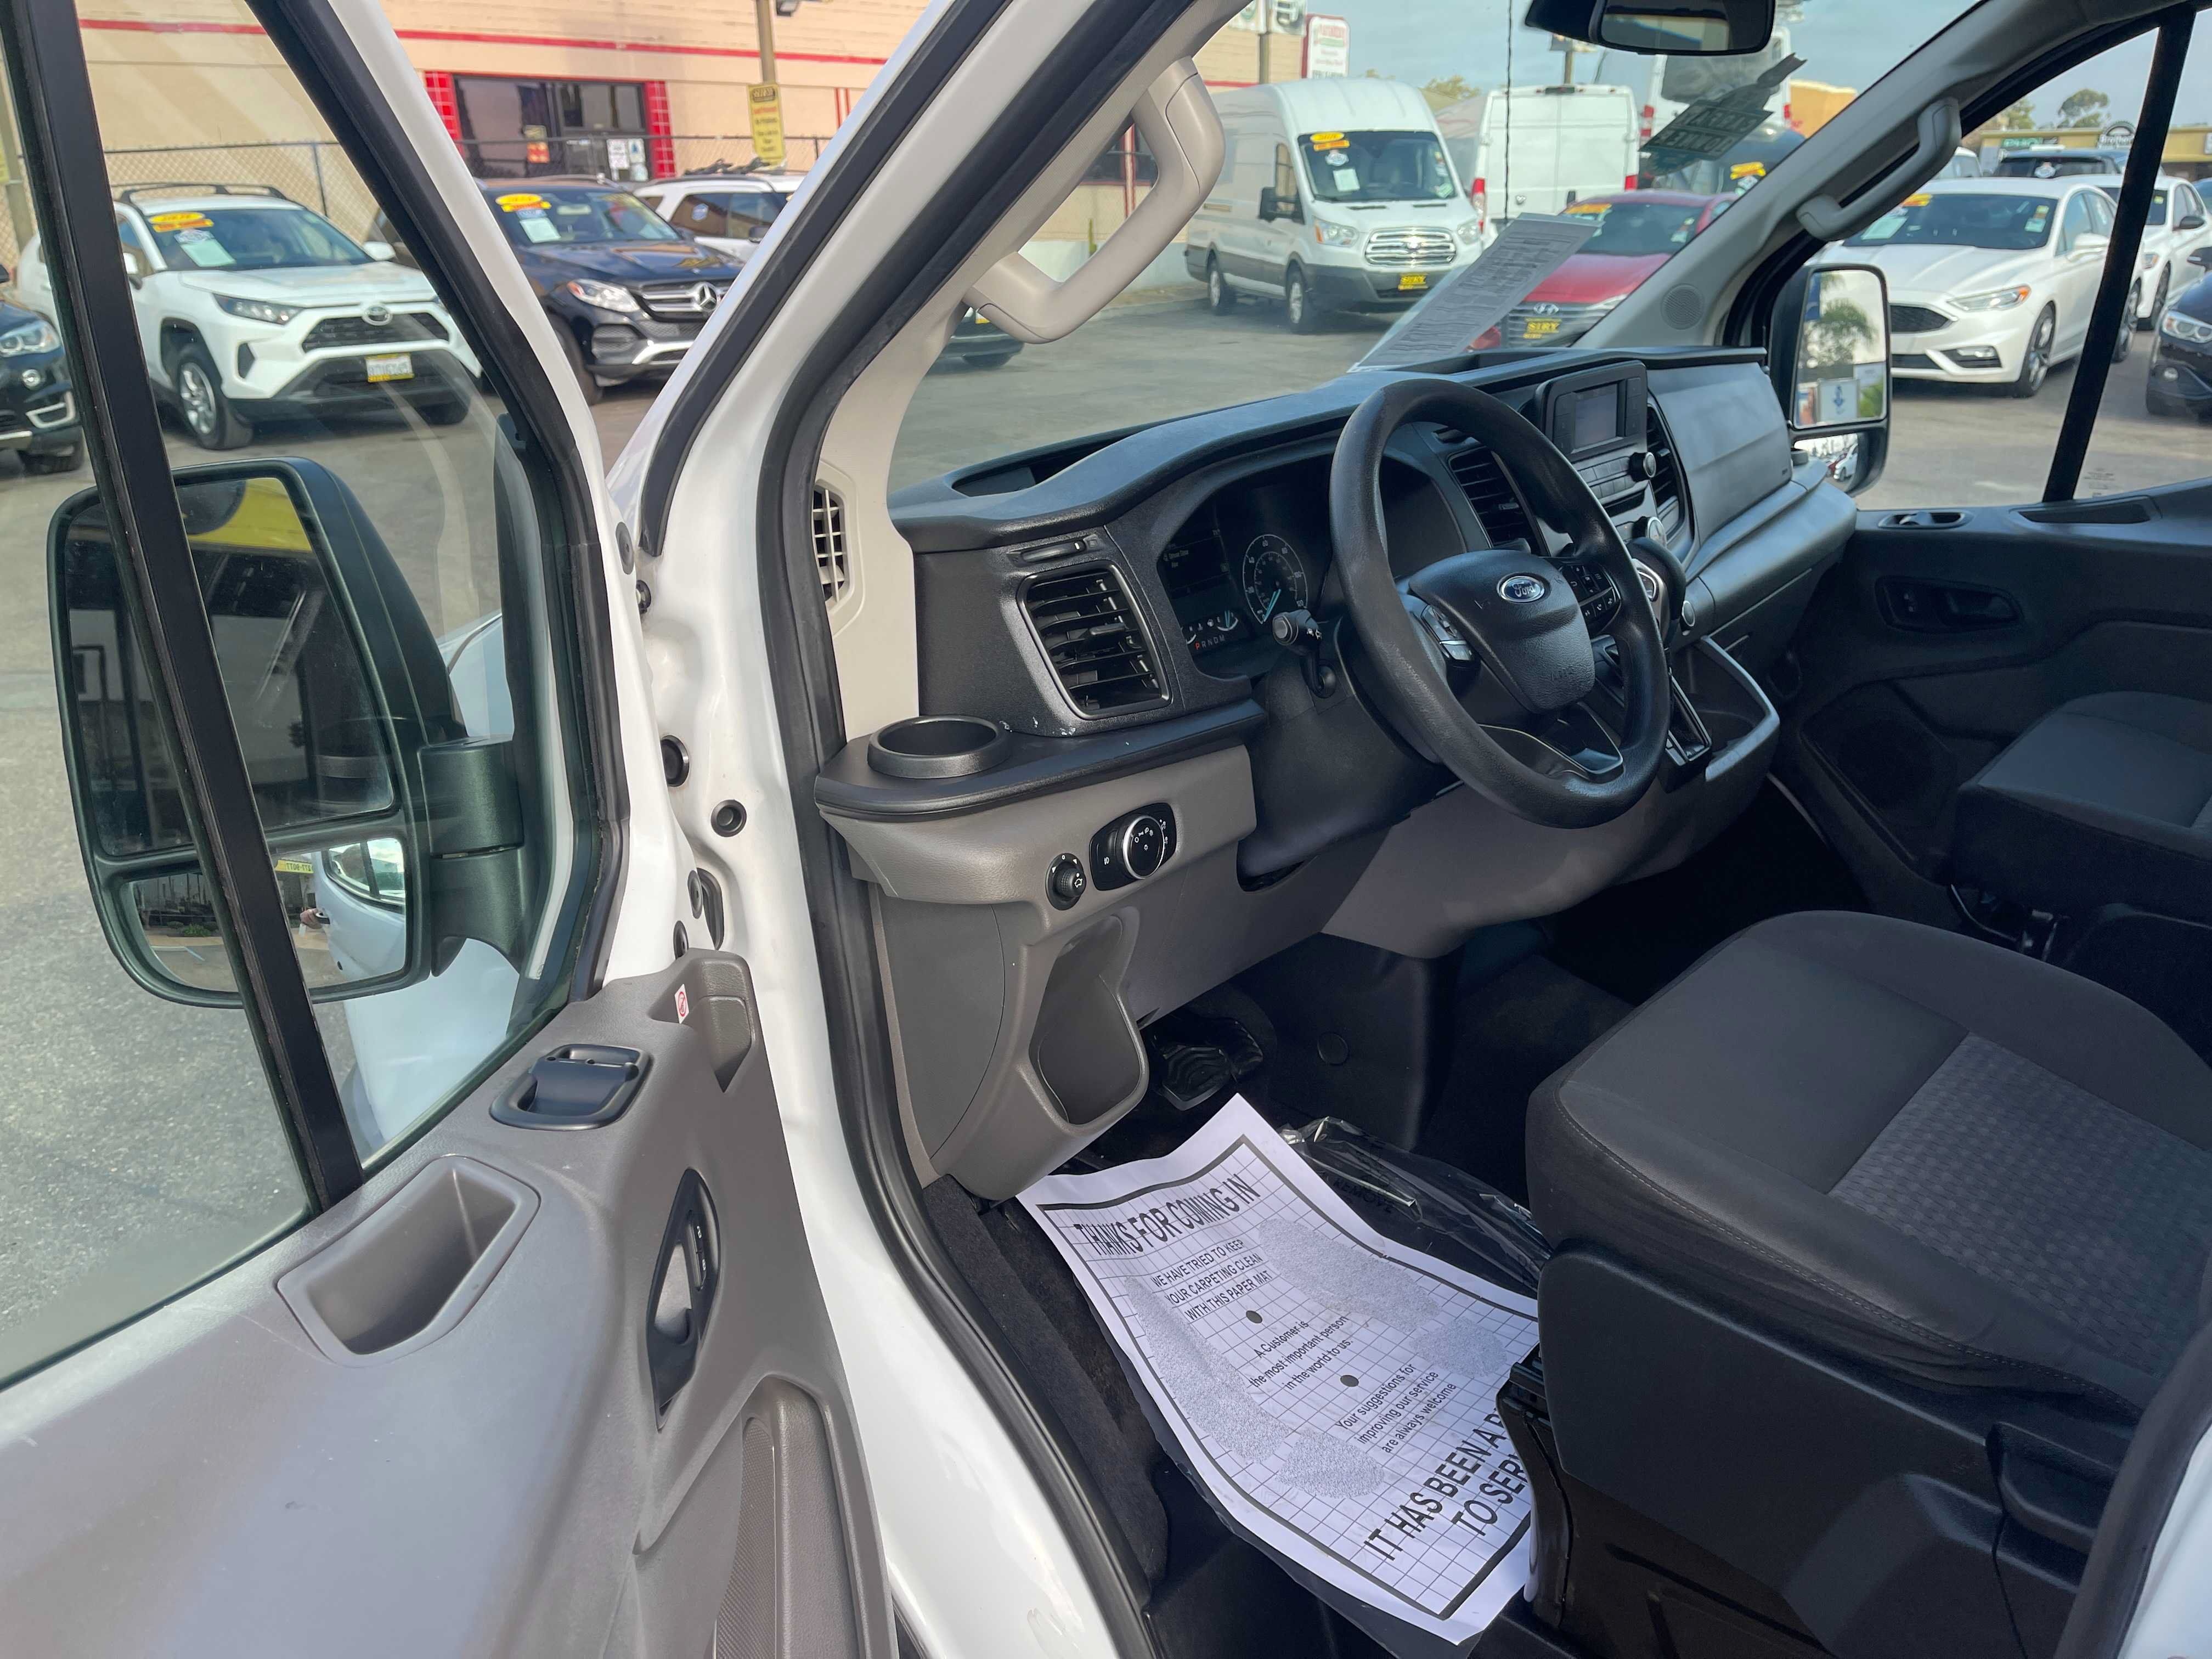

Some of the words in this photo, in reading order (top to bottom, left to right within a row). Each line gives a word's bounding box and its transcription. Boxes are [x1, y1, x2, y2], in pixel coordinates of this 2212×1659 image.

[1511, 580, 1537, 597] Ford
[1073, 1221, 1144, 1255] THANKS
[1128, 1208, 1183, 1248] FOR
[1165, 1188, 1240, 1229] COMING
[1222, 1173, 1261, 1204] IN
[1151, 1275, 1167, 1287] WE
[1163, 1265, 1190, 1283] HAVE
[1186, 1253, 1215, 1271] TRIED
[1210, 1246, 1227, 1259] TO
[1223, 1239, 1244, 1254] KEEP
[1164, 1288, 1192, 1305] YOUR
[1188, 1264, 1237, 1295] CARPETING
[1235, 1253, 1263, 1270] CLEAN
[1184, 1303, 1211, 1321] WITH
[1206, 1293, 1230, 1308] THIS
[1226, 1279, 1258, 1300] PAPER
[1252, 1270, 1273, 1285] MAT
[1248, 1375, 1267, 1388] the
[1264, 1359, 1289, 1379] most
[1281, 1334, 1324, 1364] important
[1319, 1316, 1350, 1339] person
[1254, 1349, 1266, 1359] A
[1260, 1325, 1300, 1352] Customer
[1295, 1321, 1309, 1329] is
[1282, 1382, 1298, 1390] in
[1291, 1371, 1310, 1384] the
[1306, 1352, 1333, 1373] world
[1327, 1347, 1340, 1356] to
[1338, 1339, 1354, 1349] us.
[1335, 1413, 1361, 1430] Your
[1357, 1374, 1406, 1415] suggestions
[1398, 1364, 1417, 1375] for
[1354, 1408, 1402, 1444] improving
[1396, 1396, 1413, 1410] our
[1408, 1372, 1438, 1397] service
[1382, 1439, 1399, 1453] are
[1395, 1414, 1425, 1440] always
[1420, 1383, 1457, 1414] welcome
[1364, 1528, 1403, 1561] IT
[1384, 1492, 1443, 1539] HAS
[1423, 1440, 1492, 1498] BEEN
[1472, 1429, 1508, 1449] A
[1451, 1499, 1498, 1536] TO
